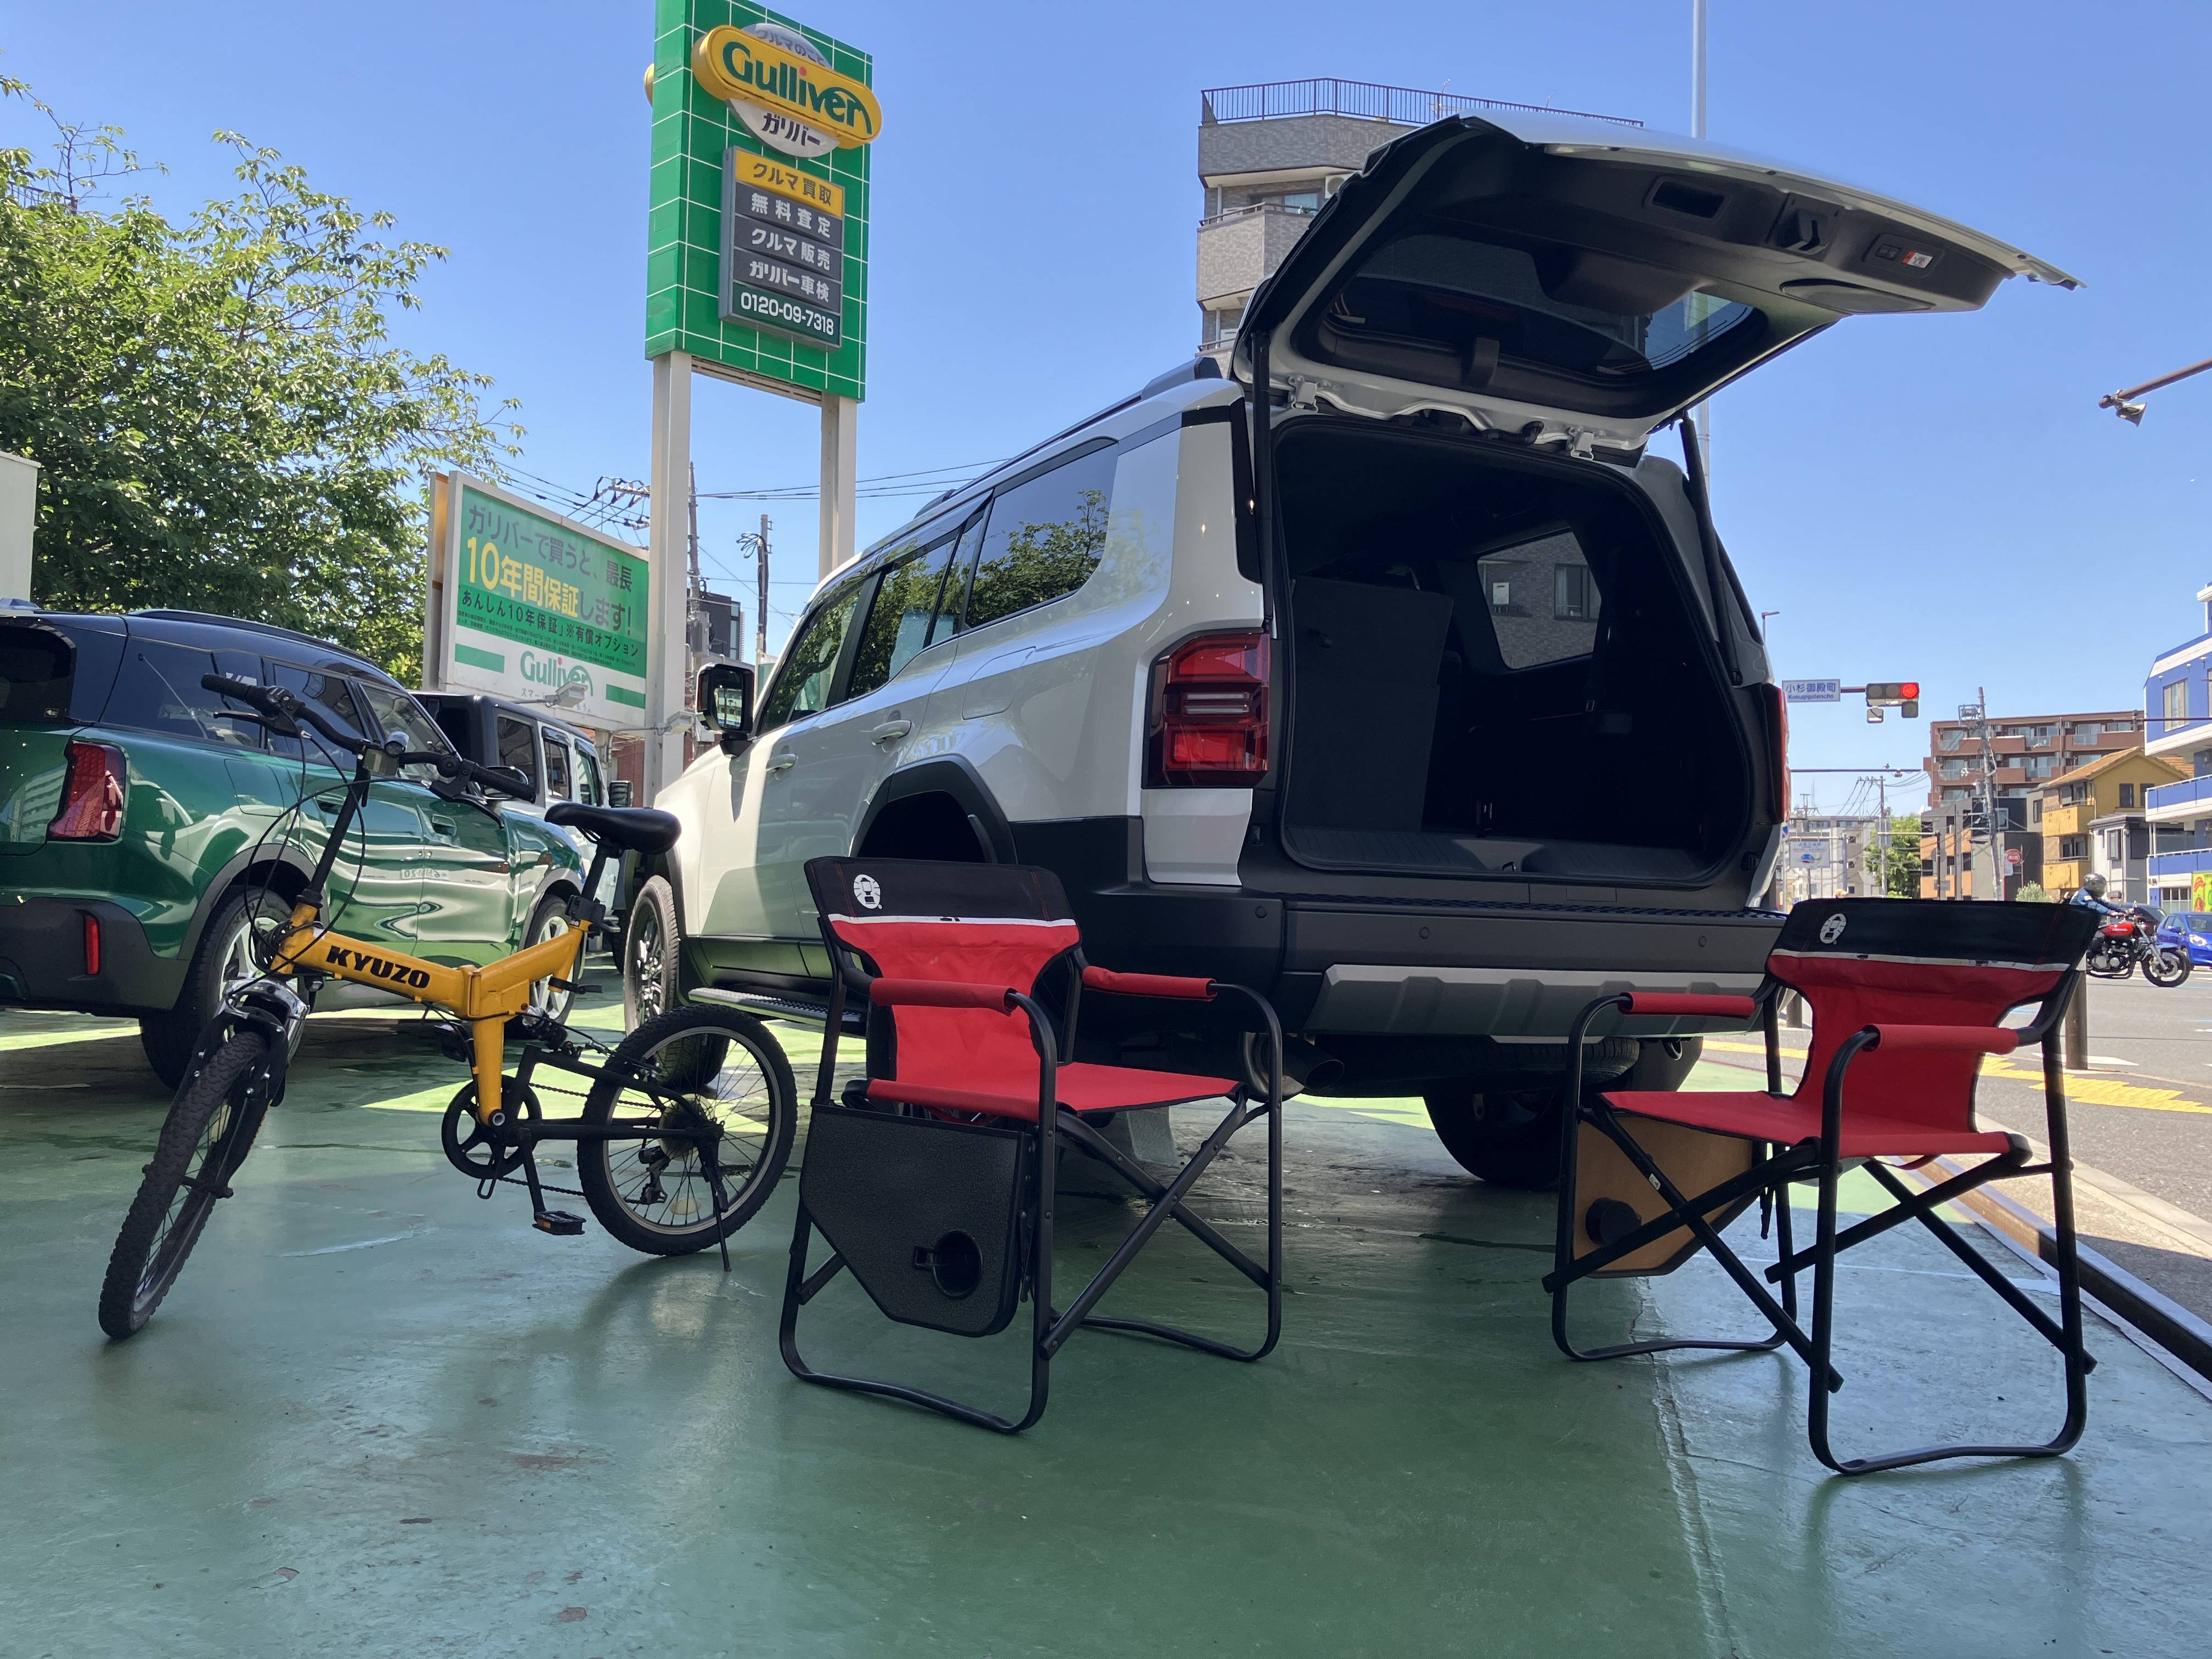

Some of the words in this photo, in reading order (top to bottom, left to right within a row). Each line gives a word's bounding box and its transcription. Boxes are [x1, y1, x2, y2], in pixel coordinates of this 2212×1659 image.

[722, 41, 872, 135] Gulliver
[761, 112, 821, 146] ガリバー
[753, 162, 832, 206] クルマ買取
[751, 193, 830, 239] 無料査定
[751, 228, 830, 271] クルマ販売
[749, 261, 830, 303] ガリバー車検
[741, 292, 834, 336] 0120-09-7318
[520, 651, 594, 697] Gulliver
[1785, 682, 1836, 693] 小杉御殿町
[326, 945, 430, 989] KYUZO
